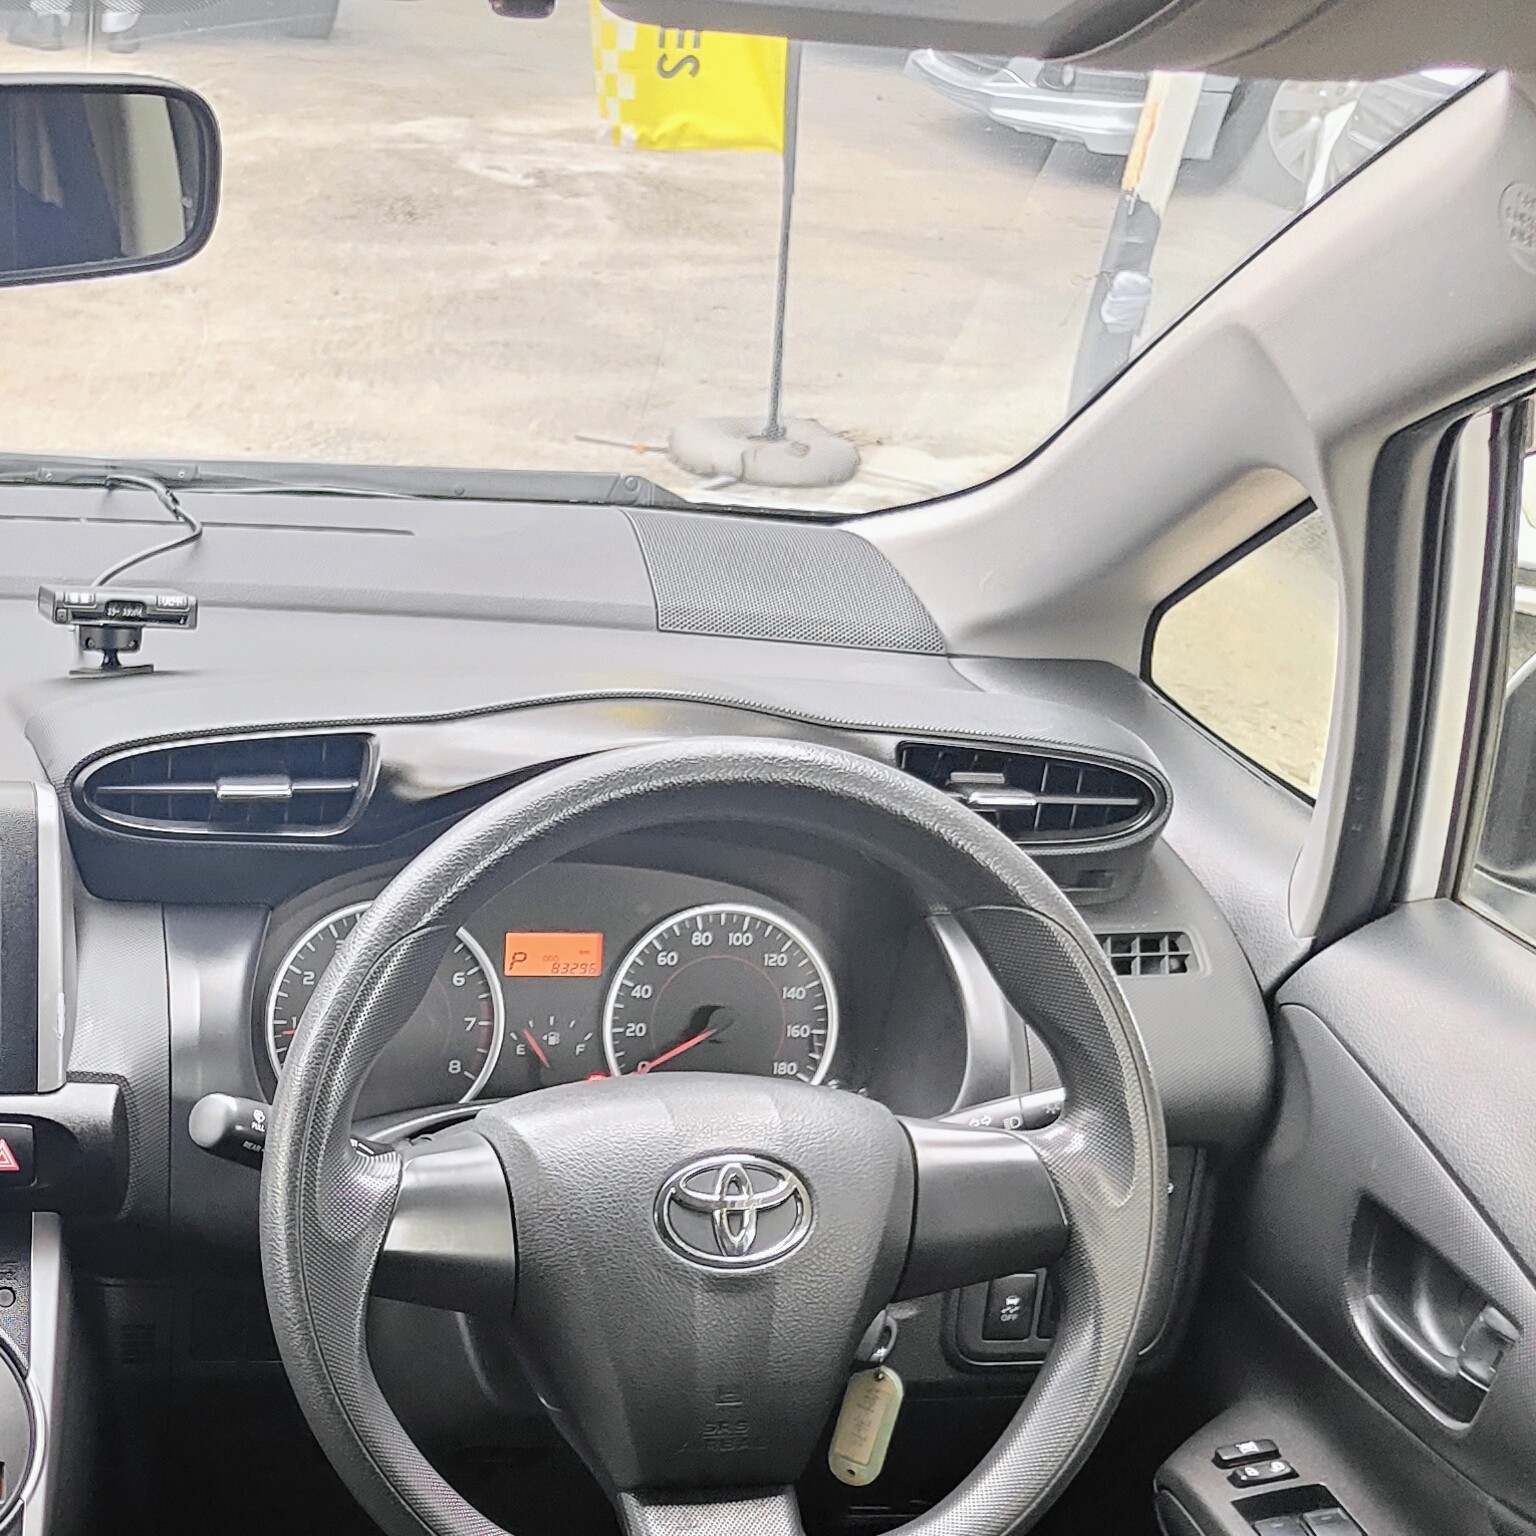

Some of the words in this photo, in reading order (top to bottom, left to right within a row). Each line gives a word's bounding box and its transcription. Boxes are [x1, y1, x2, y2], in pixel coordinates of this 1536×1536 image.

[691, 931, 712, 946] 80
[728, 932, 753, 946] 100
[509, 951, 528, 971] P
[656, 952, 678, 966] 60
[764, 953, 788, 967] 120
[303, 971, 314, 985] 2
[452, 972, 465, 986] 6
[631, 984, 652, 998] 40
[782, 986, 806, 1000] 140
[464, 1017, 476, 1031] 7
[625, 1023, 646, 1037] 20
[786, 1024, 810, 1038] 160
[516, 1044, 526, 1055] E
[576, 1044, 586, 1055] F
[448, 1060, 462, 1074] 8
[773, 1062, 798, 1075] 180
[1000, 1314, 1018, 1322] OFF
